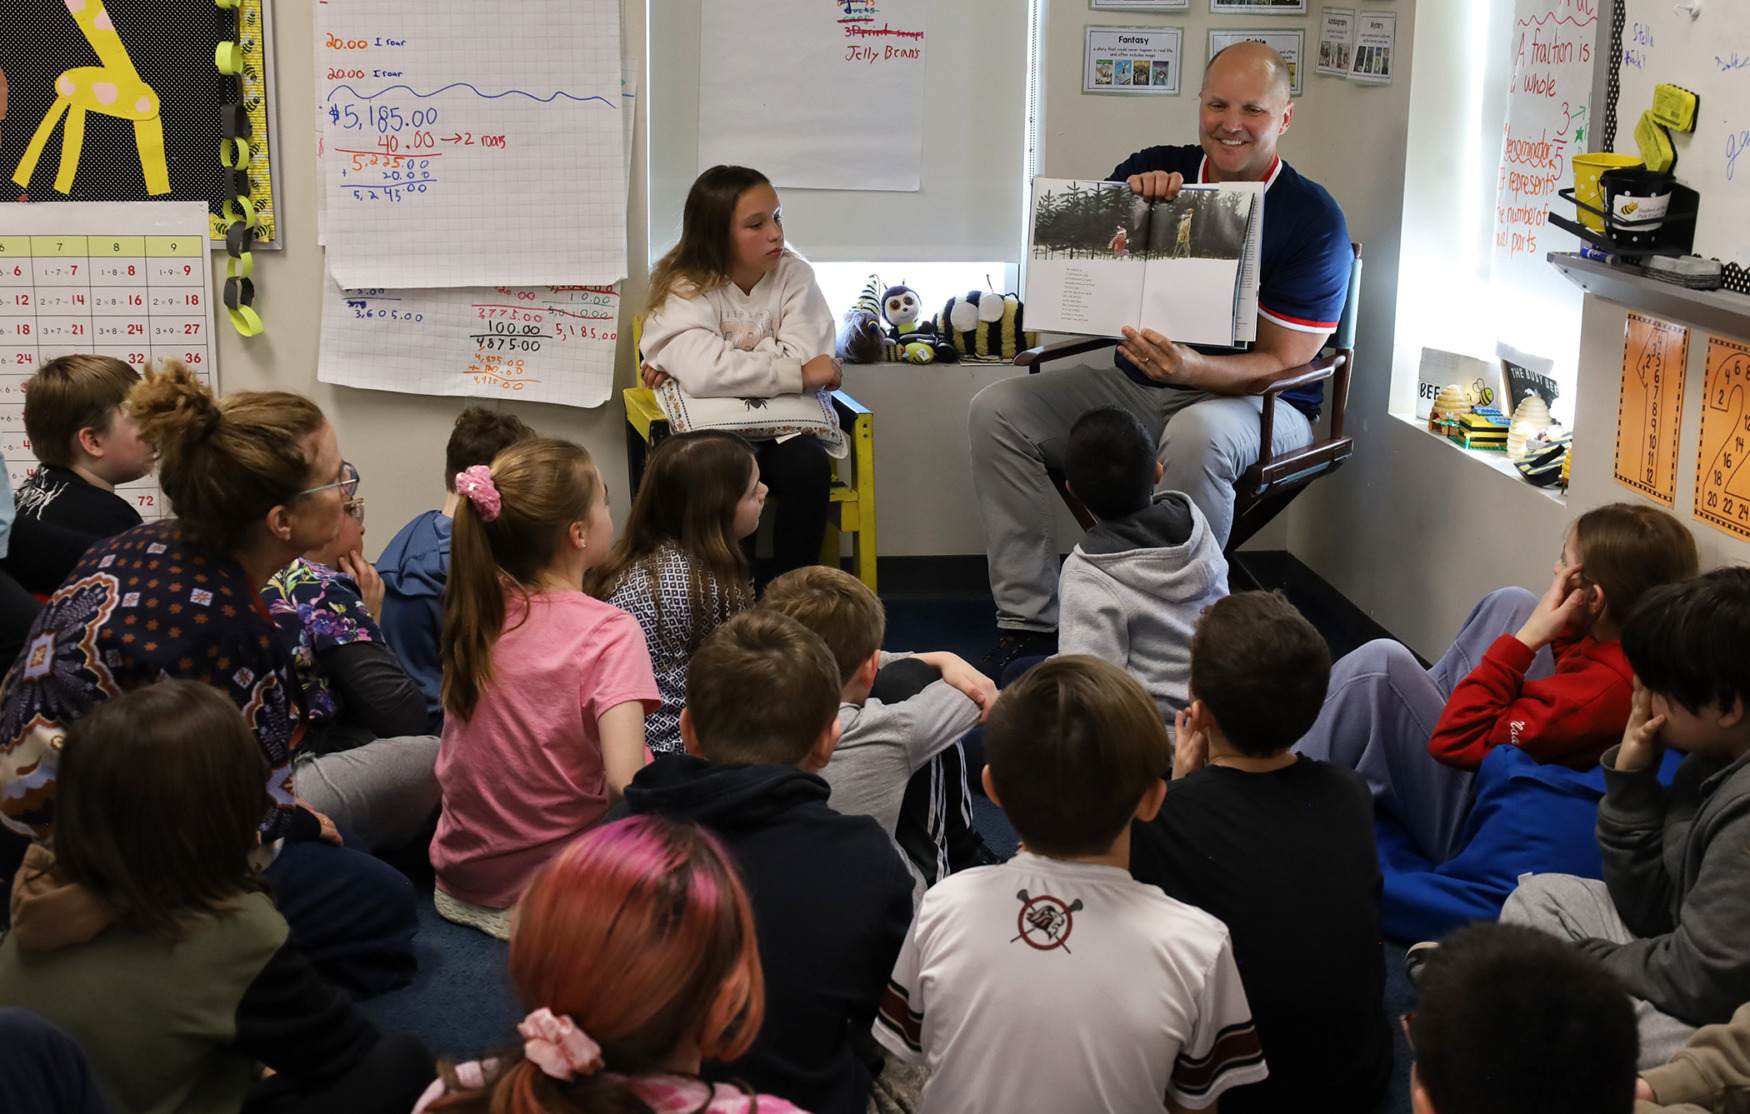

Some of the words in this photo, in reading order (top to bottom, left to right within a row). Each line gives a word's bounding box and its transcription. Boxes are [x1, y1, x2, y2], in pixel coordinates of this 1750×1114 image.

[326, 33, 368, 50] 20.00
[386, 39, 407, 47] roar
[1118, 36, 1149, 46] Fantasy
[1515, 32, 1525, 67] A
[1531, 28, 1573, 64] fraction
[1579, 35, 1590, 62] is
[845, 45, 879, 64] Jelly
[885, 45, 920, 60] Beans
[327, 68, 365, 80] 20.00
[382, 70, 403, 78] roar
[1523, 72, 1556, 97] whole
[329, 104, 438, 133] $5,185.00
[1557, 101, 1570, 136] 3
[378, 131, 435, 155] 40.00
[464, 133, 475, 145] 2
[1553, 146, 1564, 181] 5
[1509, 171, 1556, 203] represents
[1536, 203, 1549, 226] of
[57, 243, 62, 251] 7
[113, 243, 119, 251] 8
[170, 243, 177, 251] 9
[1510, 229, 1537, 259] parts
[14, 265, 21, 276] 6
[15, 295, 29, 305] 12
[71, 295, 84, 305] 14
[128, 295, 142, 305] 16
[185, 295, 199, 305] 18
[570, 292, 611, 304] 10.00
[355, 309, 423, 322] 3,605.00
[478, 308, 542, 323] 3775.00
[16, 324, 30, 335] 18
[71, 324, 83, 335] 21
[127, 324, 143, 335] 24
[184, 324, 200, 335] 27
[489, 320, 541, 335] 100.00
[556, 323, 618, 341] 5,185.00
[1651, 343, 1657, 358] 3
[16, 354, 32, 364] 24
[128, 353, 144, 364] 32
[185, 353, 201, 364] 36
[1645, 354, 1651, 369] 2
[1655, 352, 1661, 367] 5
[1734, 360, 1740, 375] 6
[1511, 367, 1525, 380] THE
[1525, 369, 1544, 386] BUSY
[1545, 377, 1560, 398] BEE
[1654, 369, 1660, 383] 6
[1725, 368, 1731, 384] 4
[1420, 382, 1441, 401] BEE
[1654, 385, 1659, 399] 7
[1718, 388, 1724, 405] 2
[1652, 402, 1657, 417] 8
[1651, 418, 1656, 433] 9
[1649, 433, 1656, 450] 10
[1735, 436, 1744, 453] 14
[1648, 450, 1655, 467] 11
[1723, 451, 1731, 468] 16
[1646, 467, 1653, 484] 12
[1714, 469, 1722, 486] 18
[137, 495, 154, 506] 72
[1707, 491, 1717, 508] 20
[1723, 497, 1733, 514] 22
[1738, 504, 1749, 522] 24
